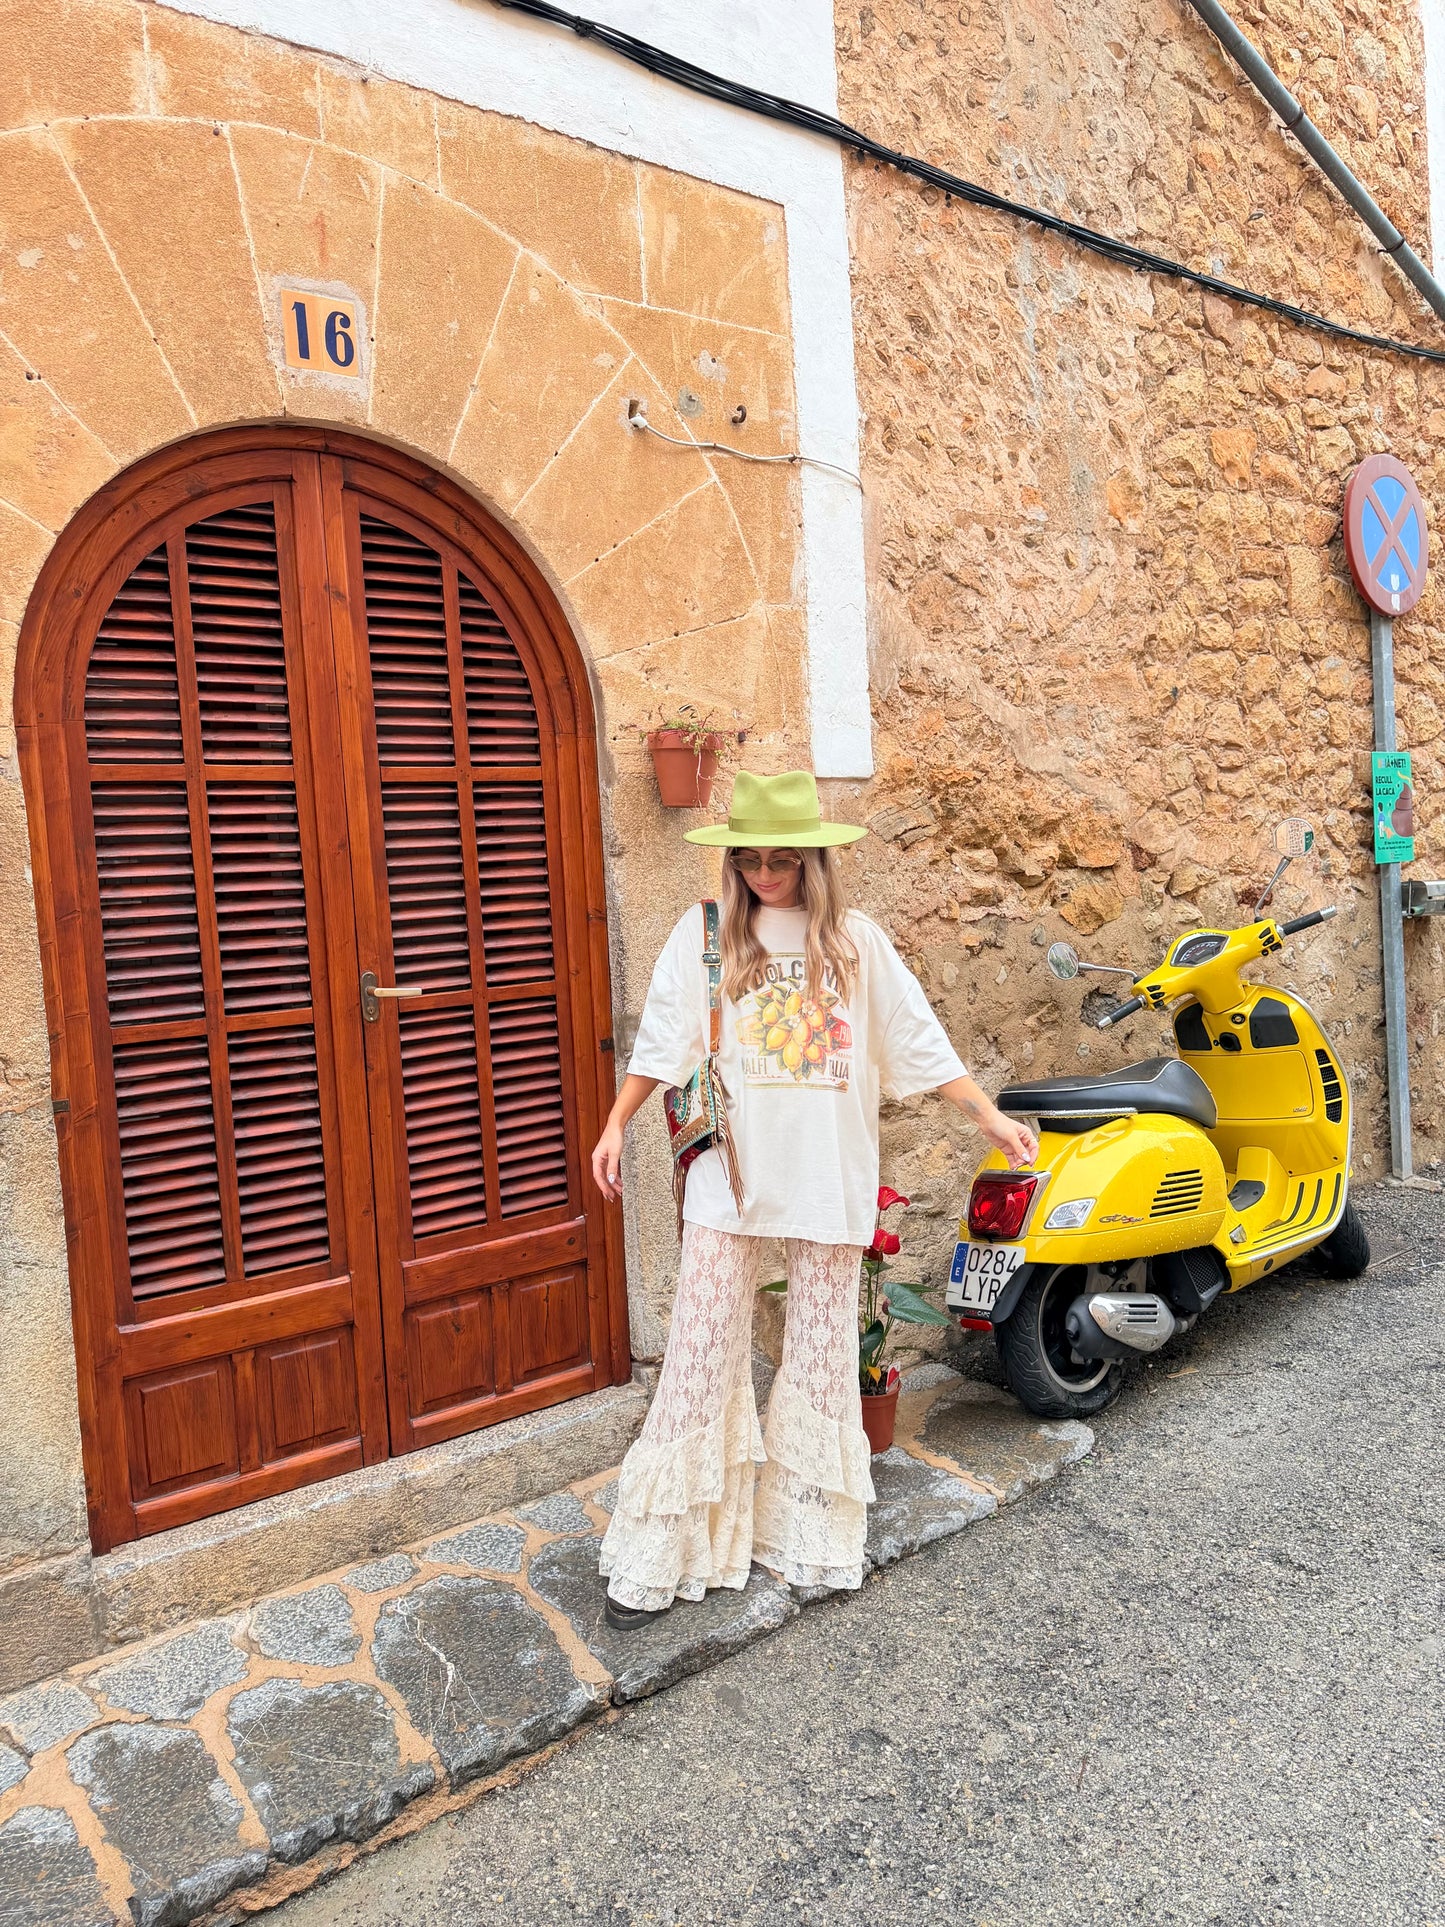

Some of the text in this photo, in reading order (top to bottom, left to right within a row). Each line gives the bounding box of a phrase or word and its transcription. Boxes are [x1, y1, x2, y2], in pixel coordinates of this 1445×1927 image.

[292, 301, 354, 367] 16
[1375, 775, 1393, 784] RECULL
[1375, 787, 1382, 796] LA
[968, 1247, 1017, 1276] 0284
[955, 1267, 961, 1277] E
[961, 1275, 1001, 1304] LYR
